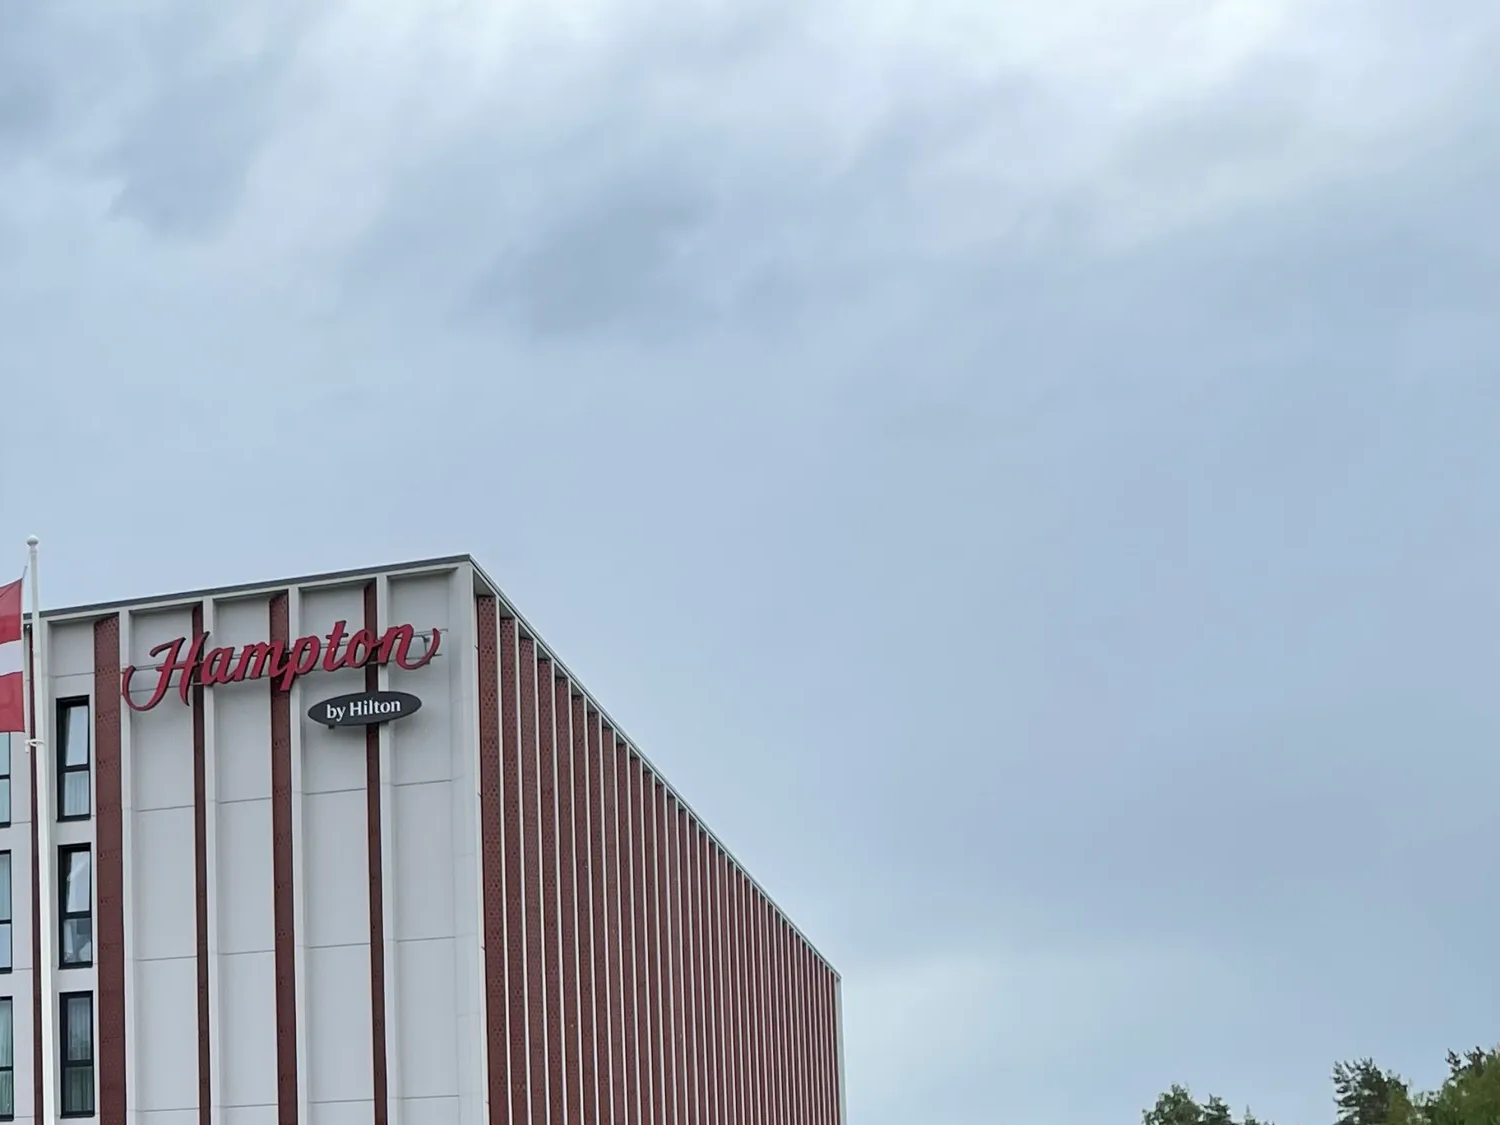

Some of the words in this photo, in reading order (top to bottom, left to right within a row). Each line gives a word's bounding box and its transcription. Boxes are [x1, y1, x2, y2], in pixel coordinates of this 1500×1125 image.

[122, 620, 440, 711] Hampton
[326, 703, 346, 721] by
[349, 700, 401, 717] Hilton
